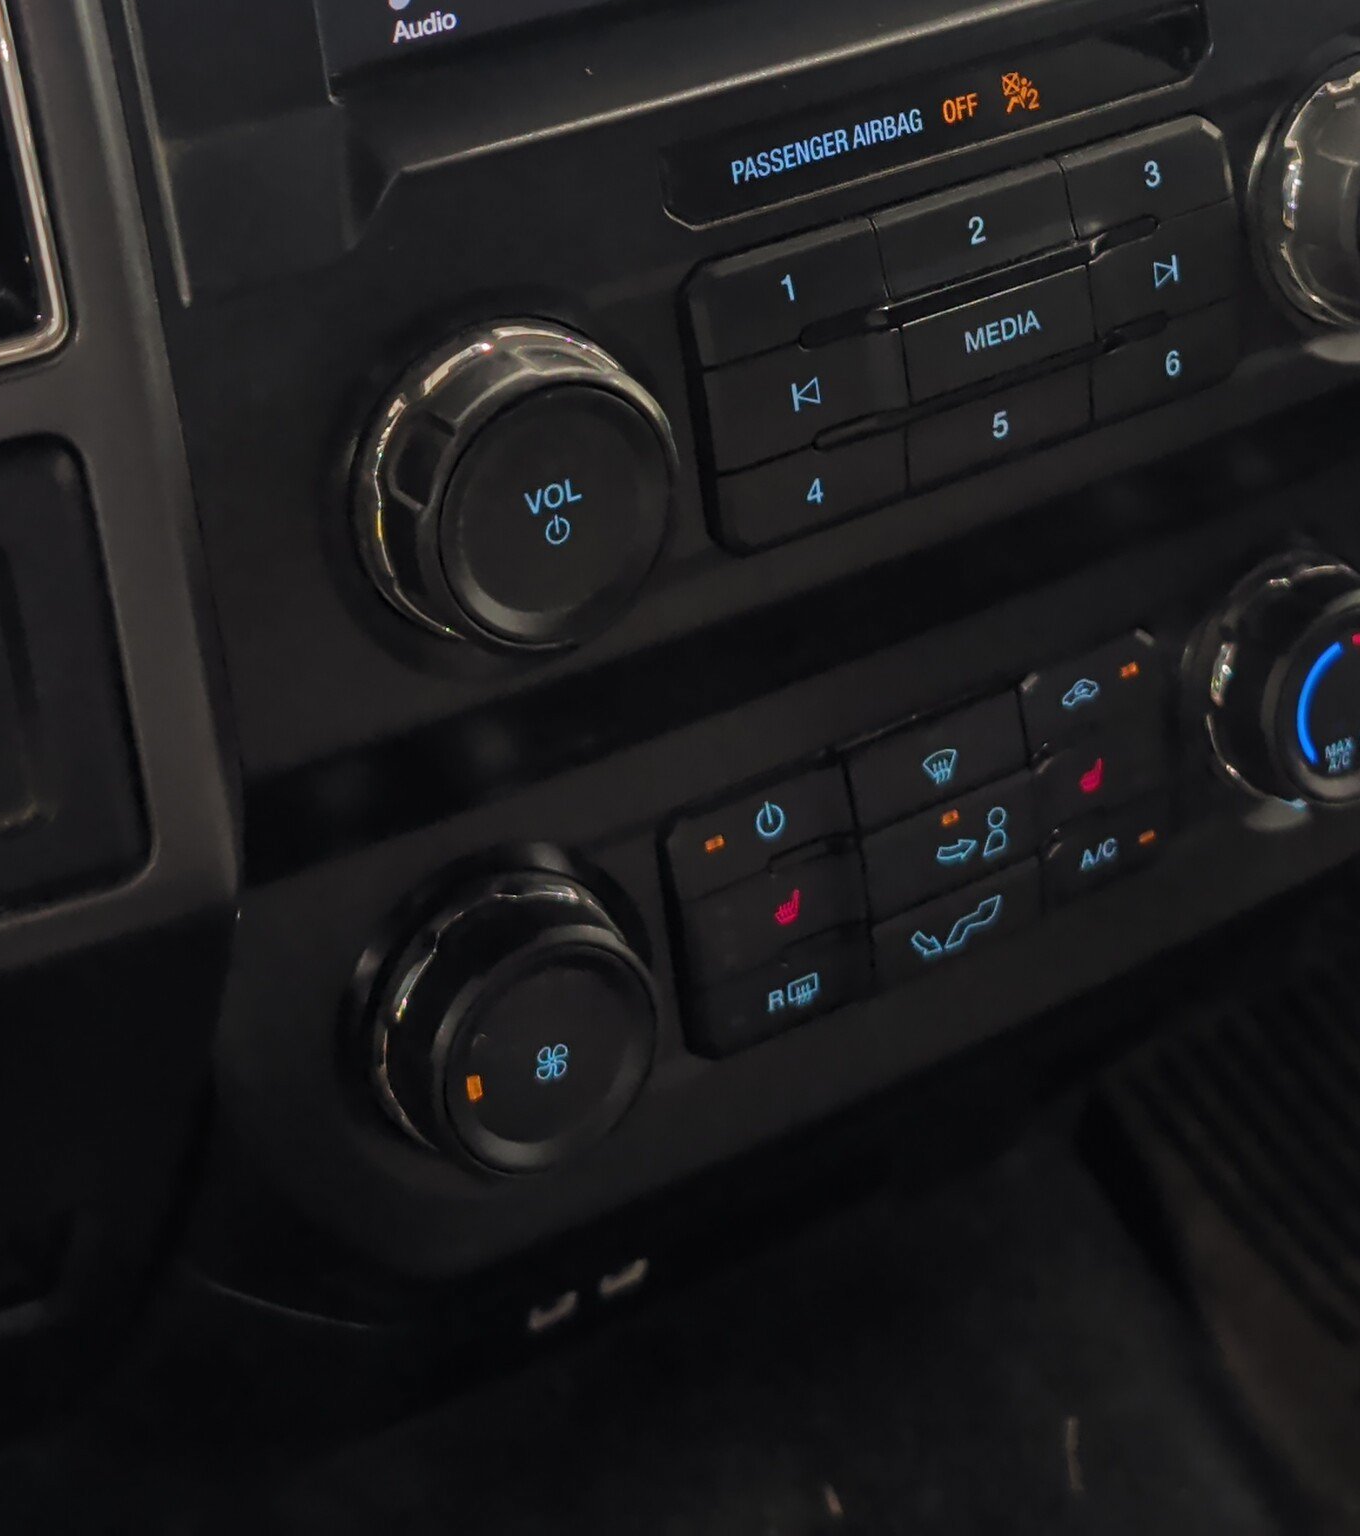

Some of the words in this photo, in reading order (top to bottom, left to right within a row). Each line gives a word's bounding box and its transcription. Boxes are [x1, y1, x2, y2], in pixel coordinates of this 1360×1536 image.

[392, 11, 457, 44] Audio
[731, 128, 849, 185] PASSENGER
[852, 108, 923, 150] AIRBAG
[942, 92, 978, 124] OFF
[1144, 160, 1161, 188] 3
[968, 215, 986, 245] 2
[780, 274, 795, 302] 1
[964, 310, 1041, 354] MEDIA
[1165, 350, 1180, 376] 6
[992, 410, 1009, 439] 5
[523, 478, 583, 515] VOL
[806, 477, 824, 504] 4
[1325, 736, 1354, 761] MAX
[1329, 751, 1352, 773] A/C
[1080, 837, 1118, 870] A/C
[768, 989, 785, 1011] R
